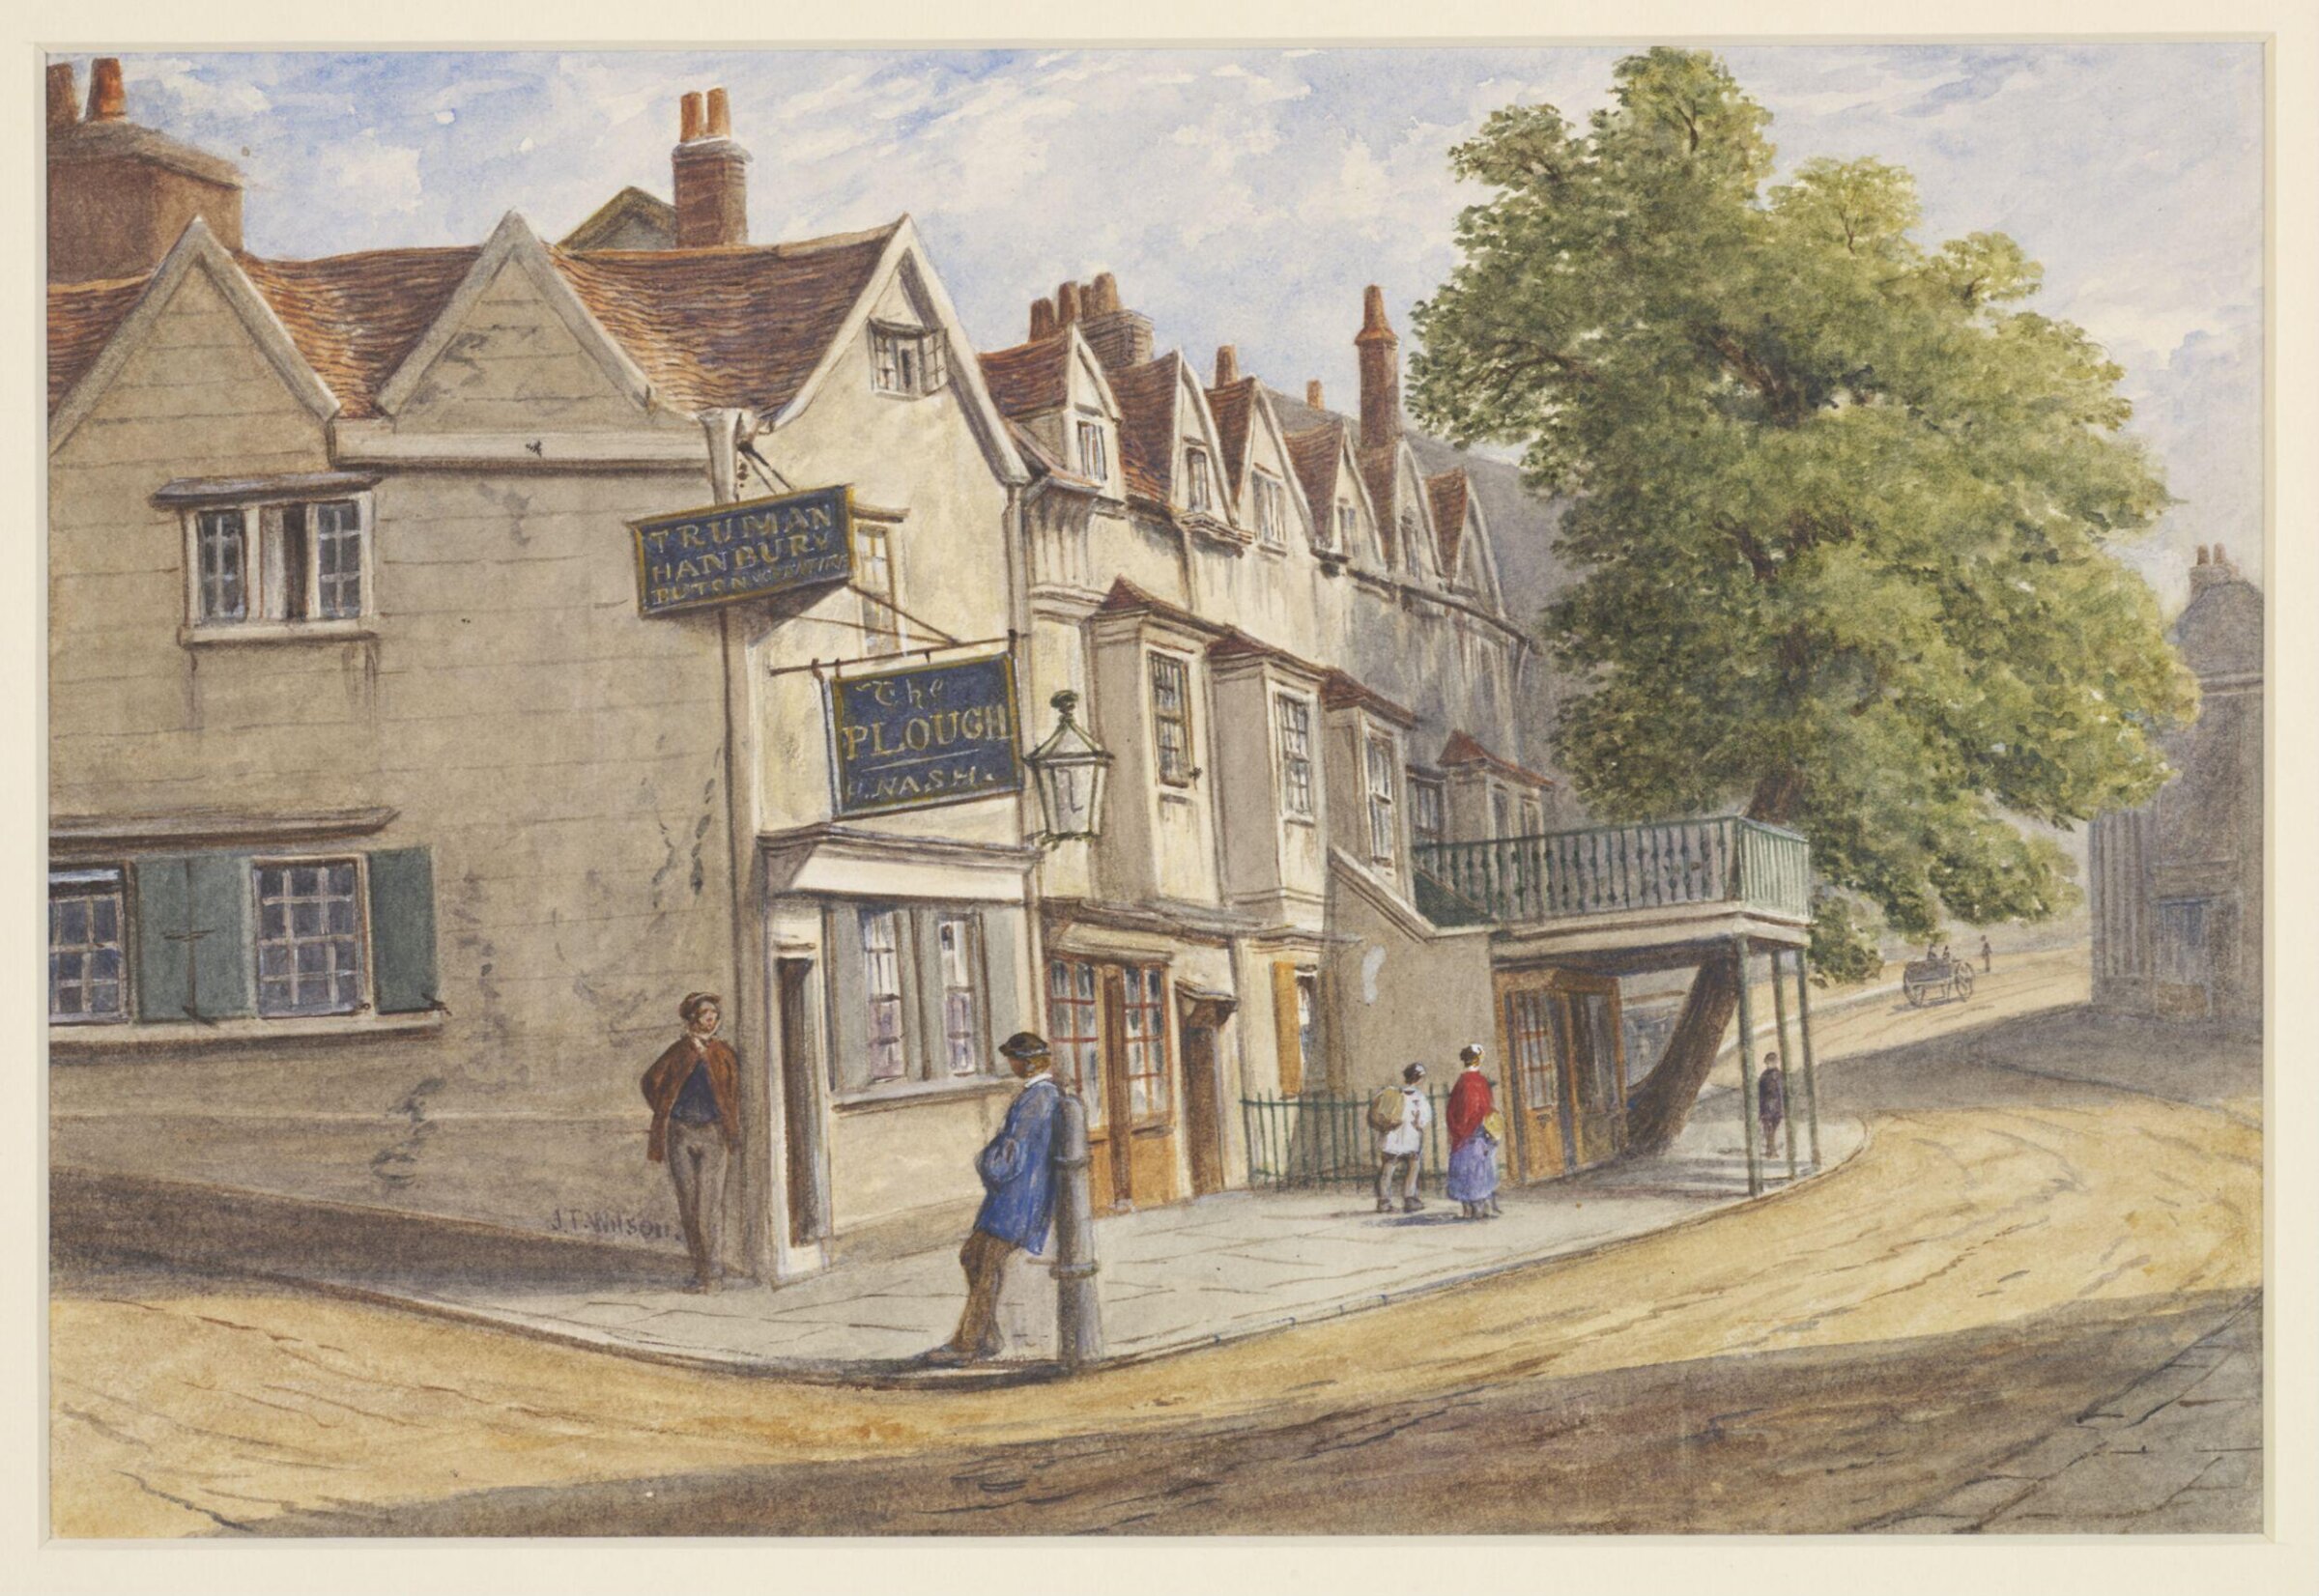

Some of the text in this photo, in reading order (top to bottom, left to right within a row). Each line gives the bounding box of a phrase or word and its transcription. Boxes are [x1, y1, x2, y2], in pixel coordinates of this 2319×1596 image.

[649, 503, 832, 554] TRUMAN
[651, 532, 829, 584] HANBURY
[856, 678, 944, 709] The
[842, 703, 1014, 761] PLOUGH
